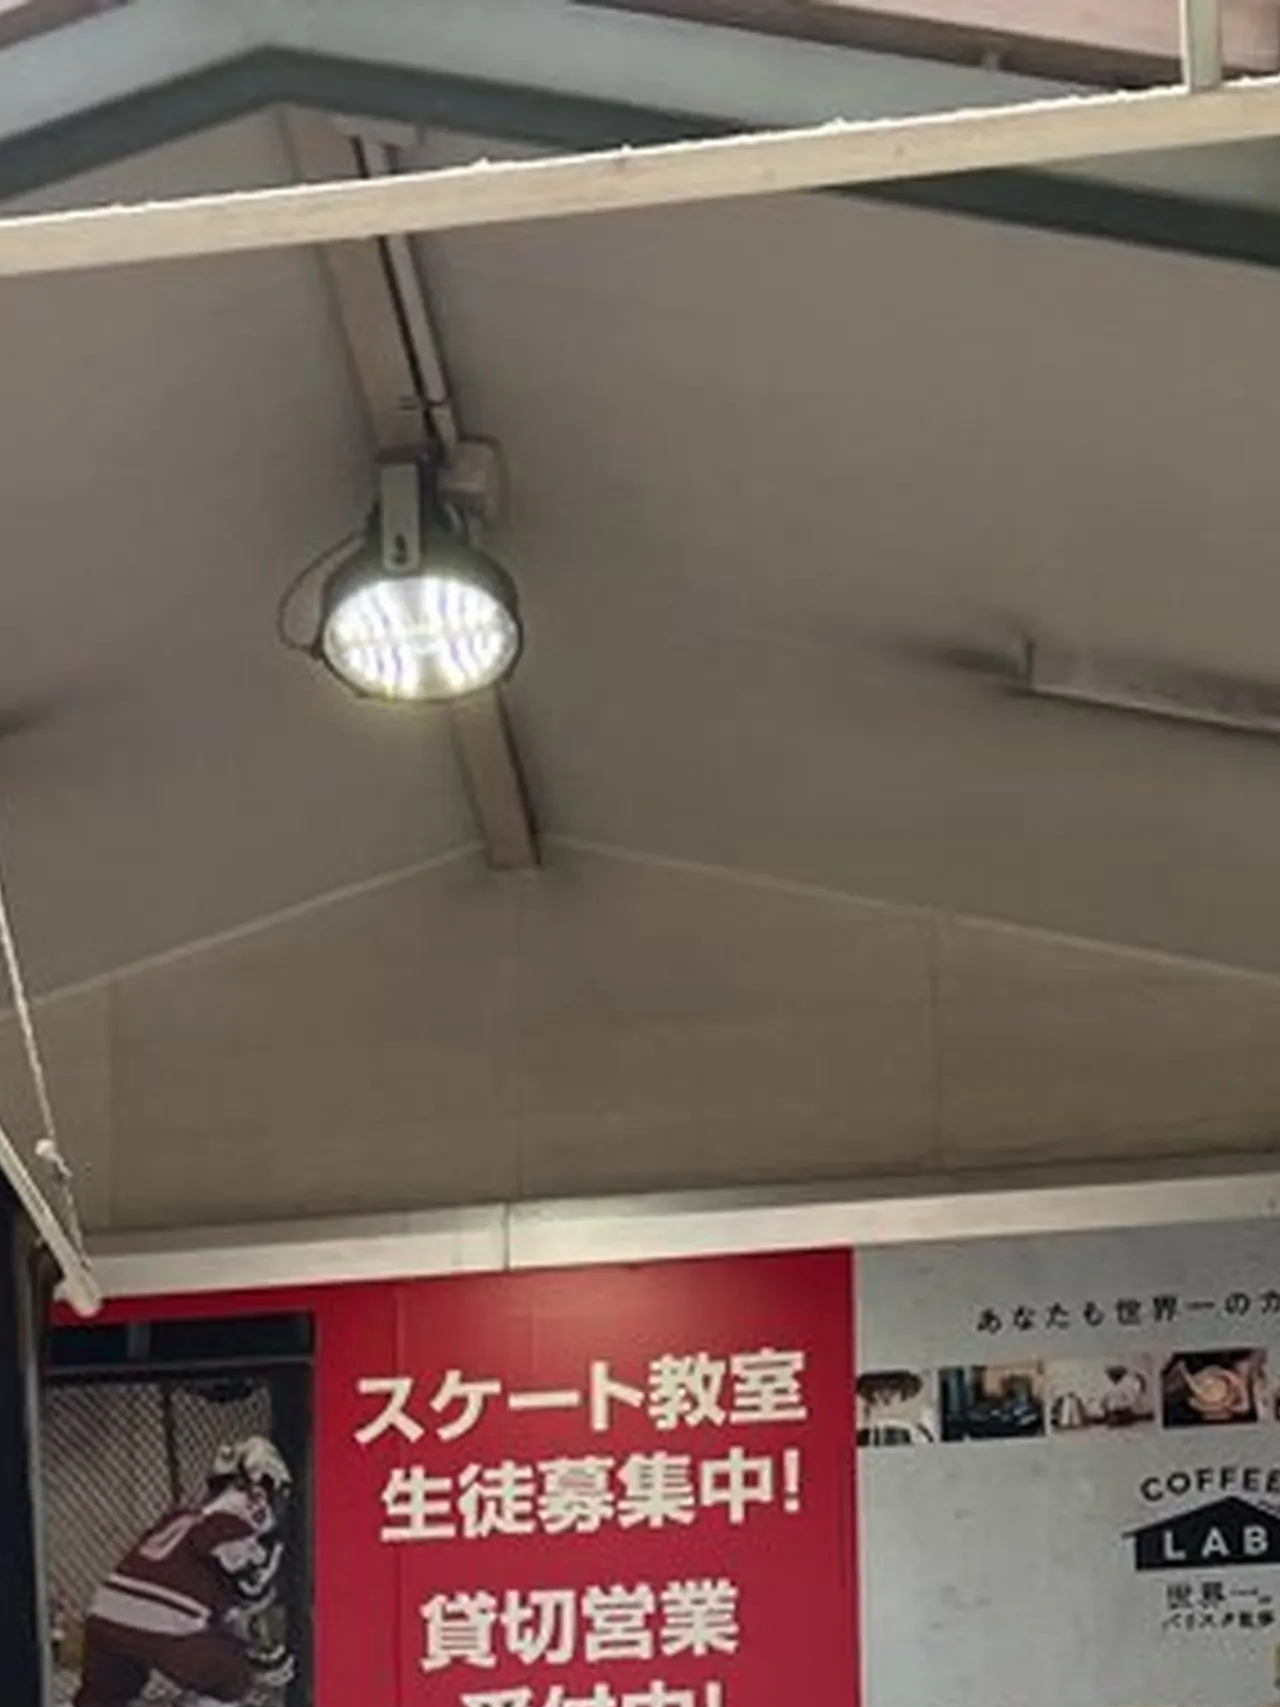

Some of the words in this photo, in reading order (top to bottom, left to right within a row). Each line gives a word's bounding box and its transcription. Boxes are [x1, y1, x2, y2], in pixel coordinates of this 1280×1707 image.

[354, 1347, 808, 1446] スケート教室
[380, 1447, 801, 1542] 生徒募集中!
[419, 1579, 740, 1673] 貸切営業
